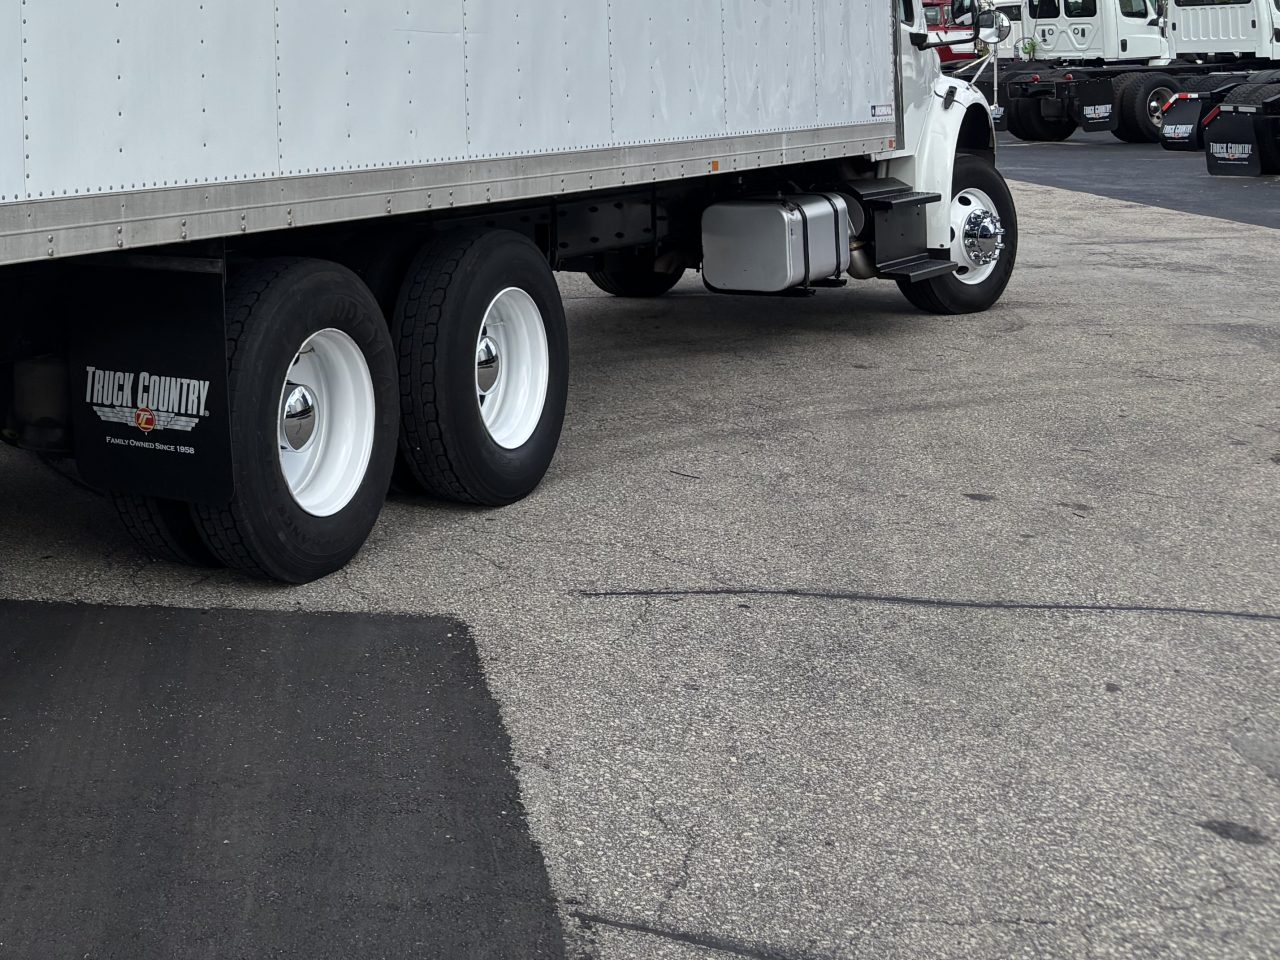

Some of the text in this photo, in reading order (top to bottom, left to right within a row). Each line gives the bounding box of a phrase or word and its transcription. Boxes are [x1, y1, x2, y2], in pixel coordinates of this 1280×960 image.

[1210, 142, 1227, 153] TRUCK
[85, 366, 210, 416] TRUCK COUNTRY
[106, 436, 195, 454] FAMILY OWNED SINCE 1958
